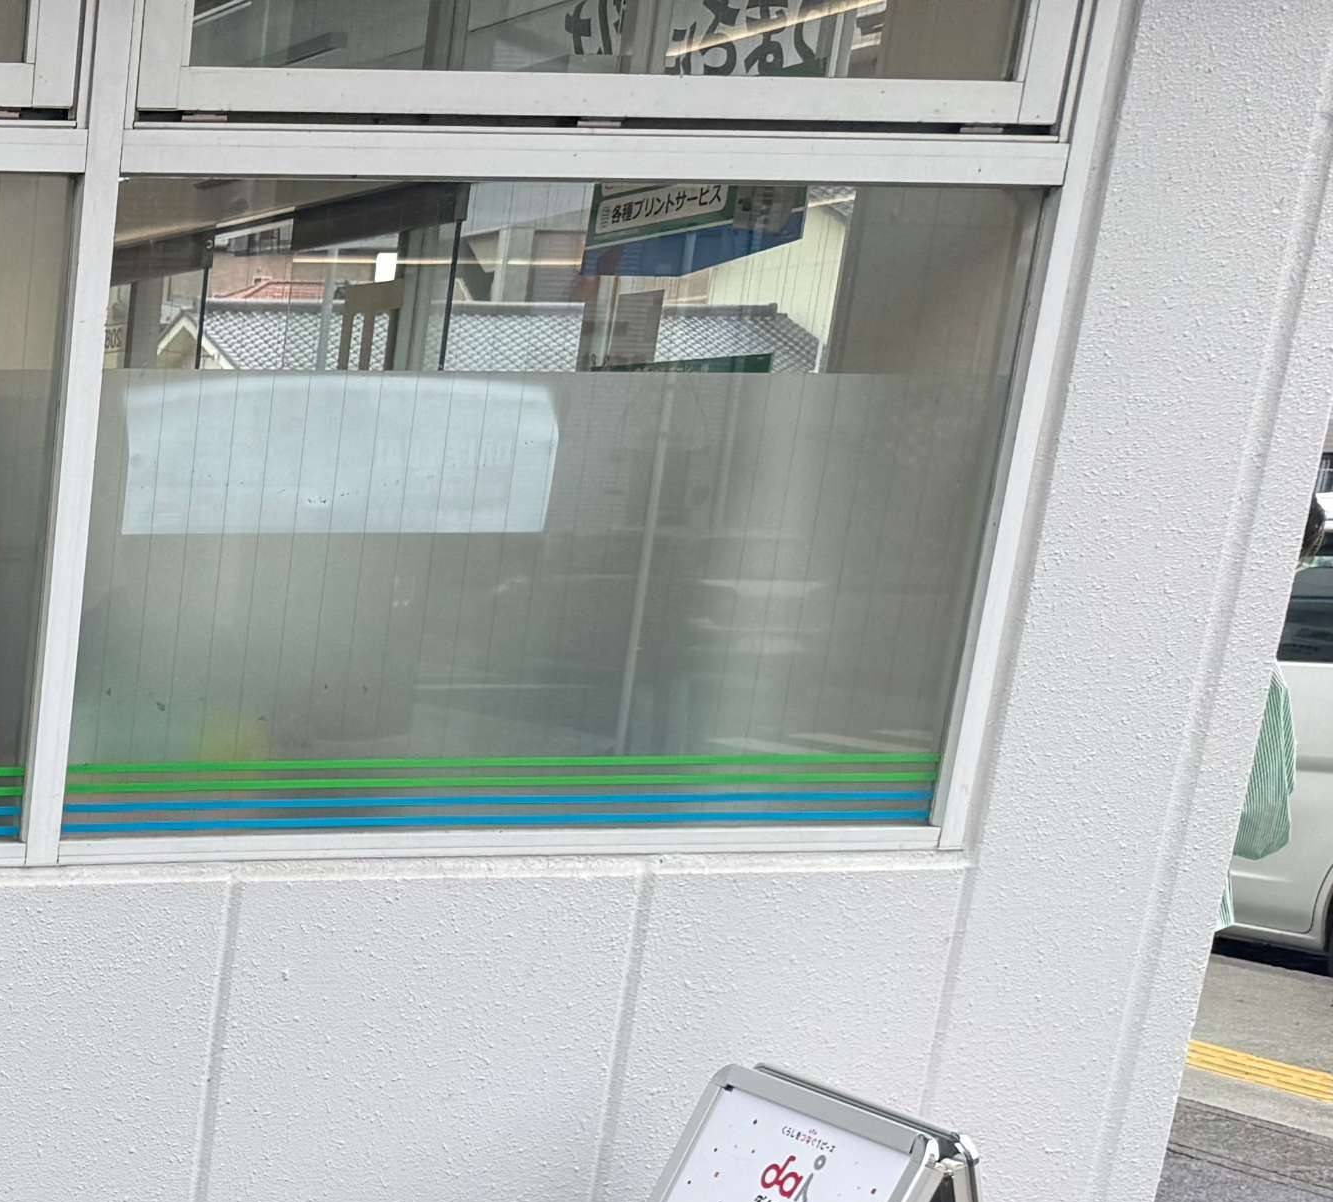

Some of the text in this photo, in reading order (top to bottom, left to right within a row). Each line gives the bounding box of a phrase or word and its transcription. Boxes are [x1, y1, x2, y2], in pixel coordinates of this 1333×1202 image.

[611, 184, 722, 224] 各種プリントサービス
